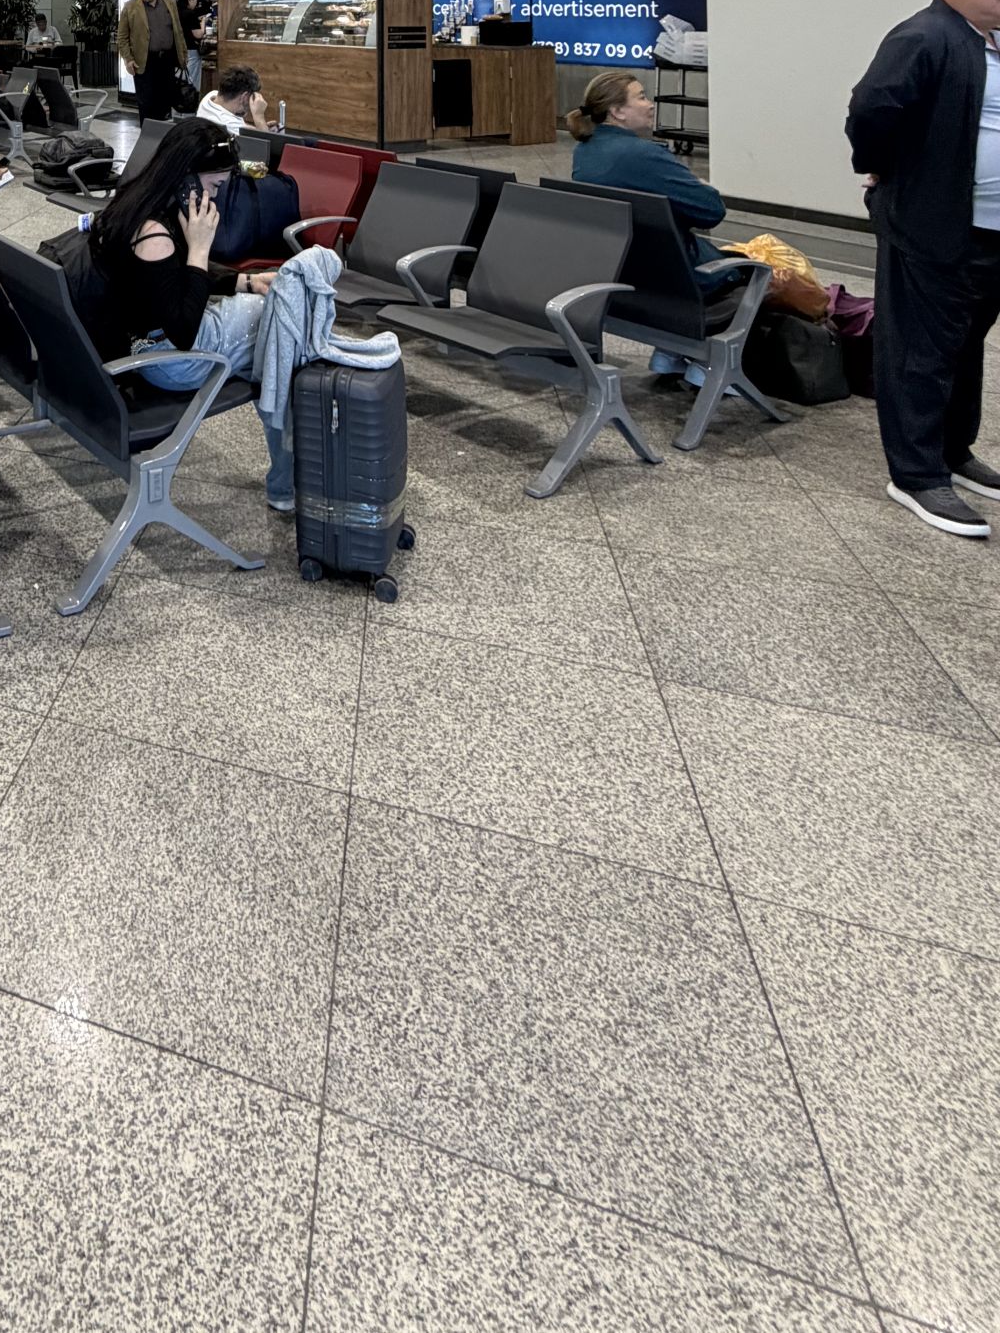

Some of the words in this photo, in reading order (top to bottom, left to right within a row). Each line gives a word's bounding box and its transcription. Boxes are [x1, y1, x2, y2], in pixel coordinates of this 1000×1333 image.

[520, 0, 659, 18] advertisement
[573, 42, 601, 57] 837
[605, 43, 627, 58] 09
[631, 44, 654, 59] 04
